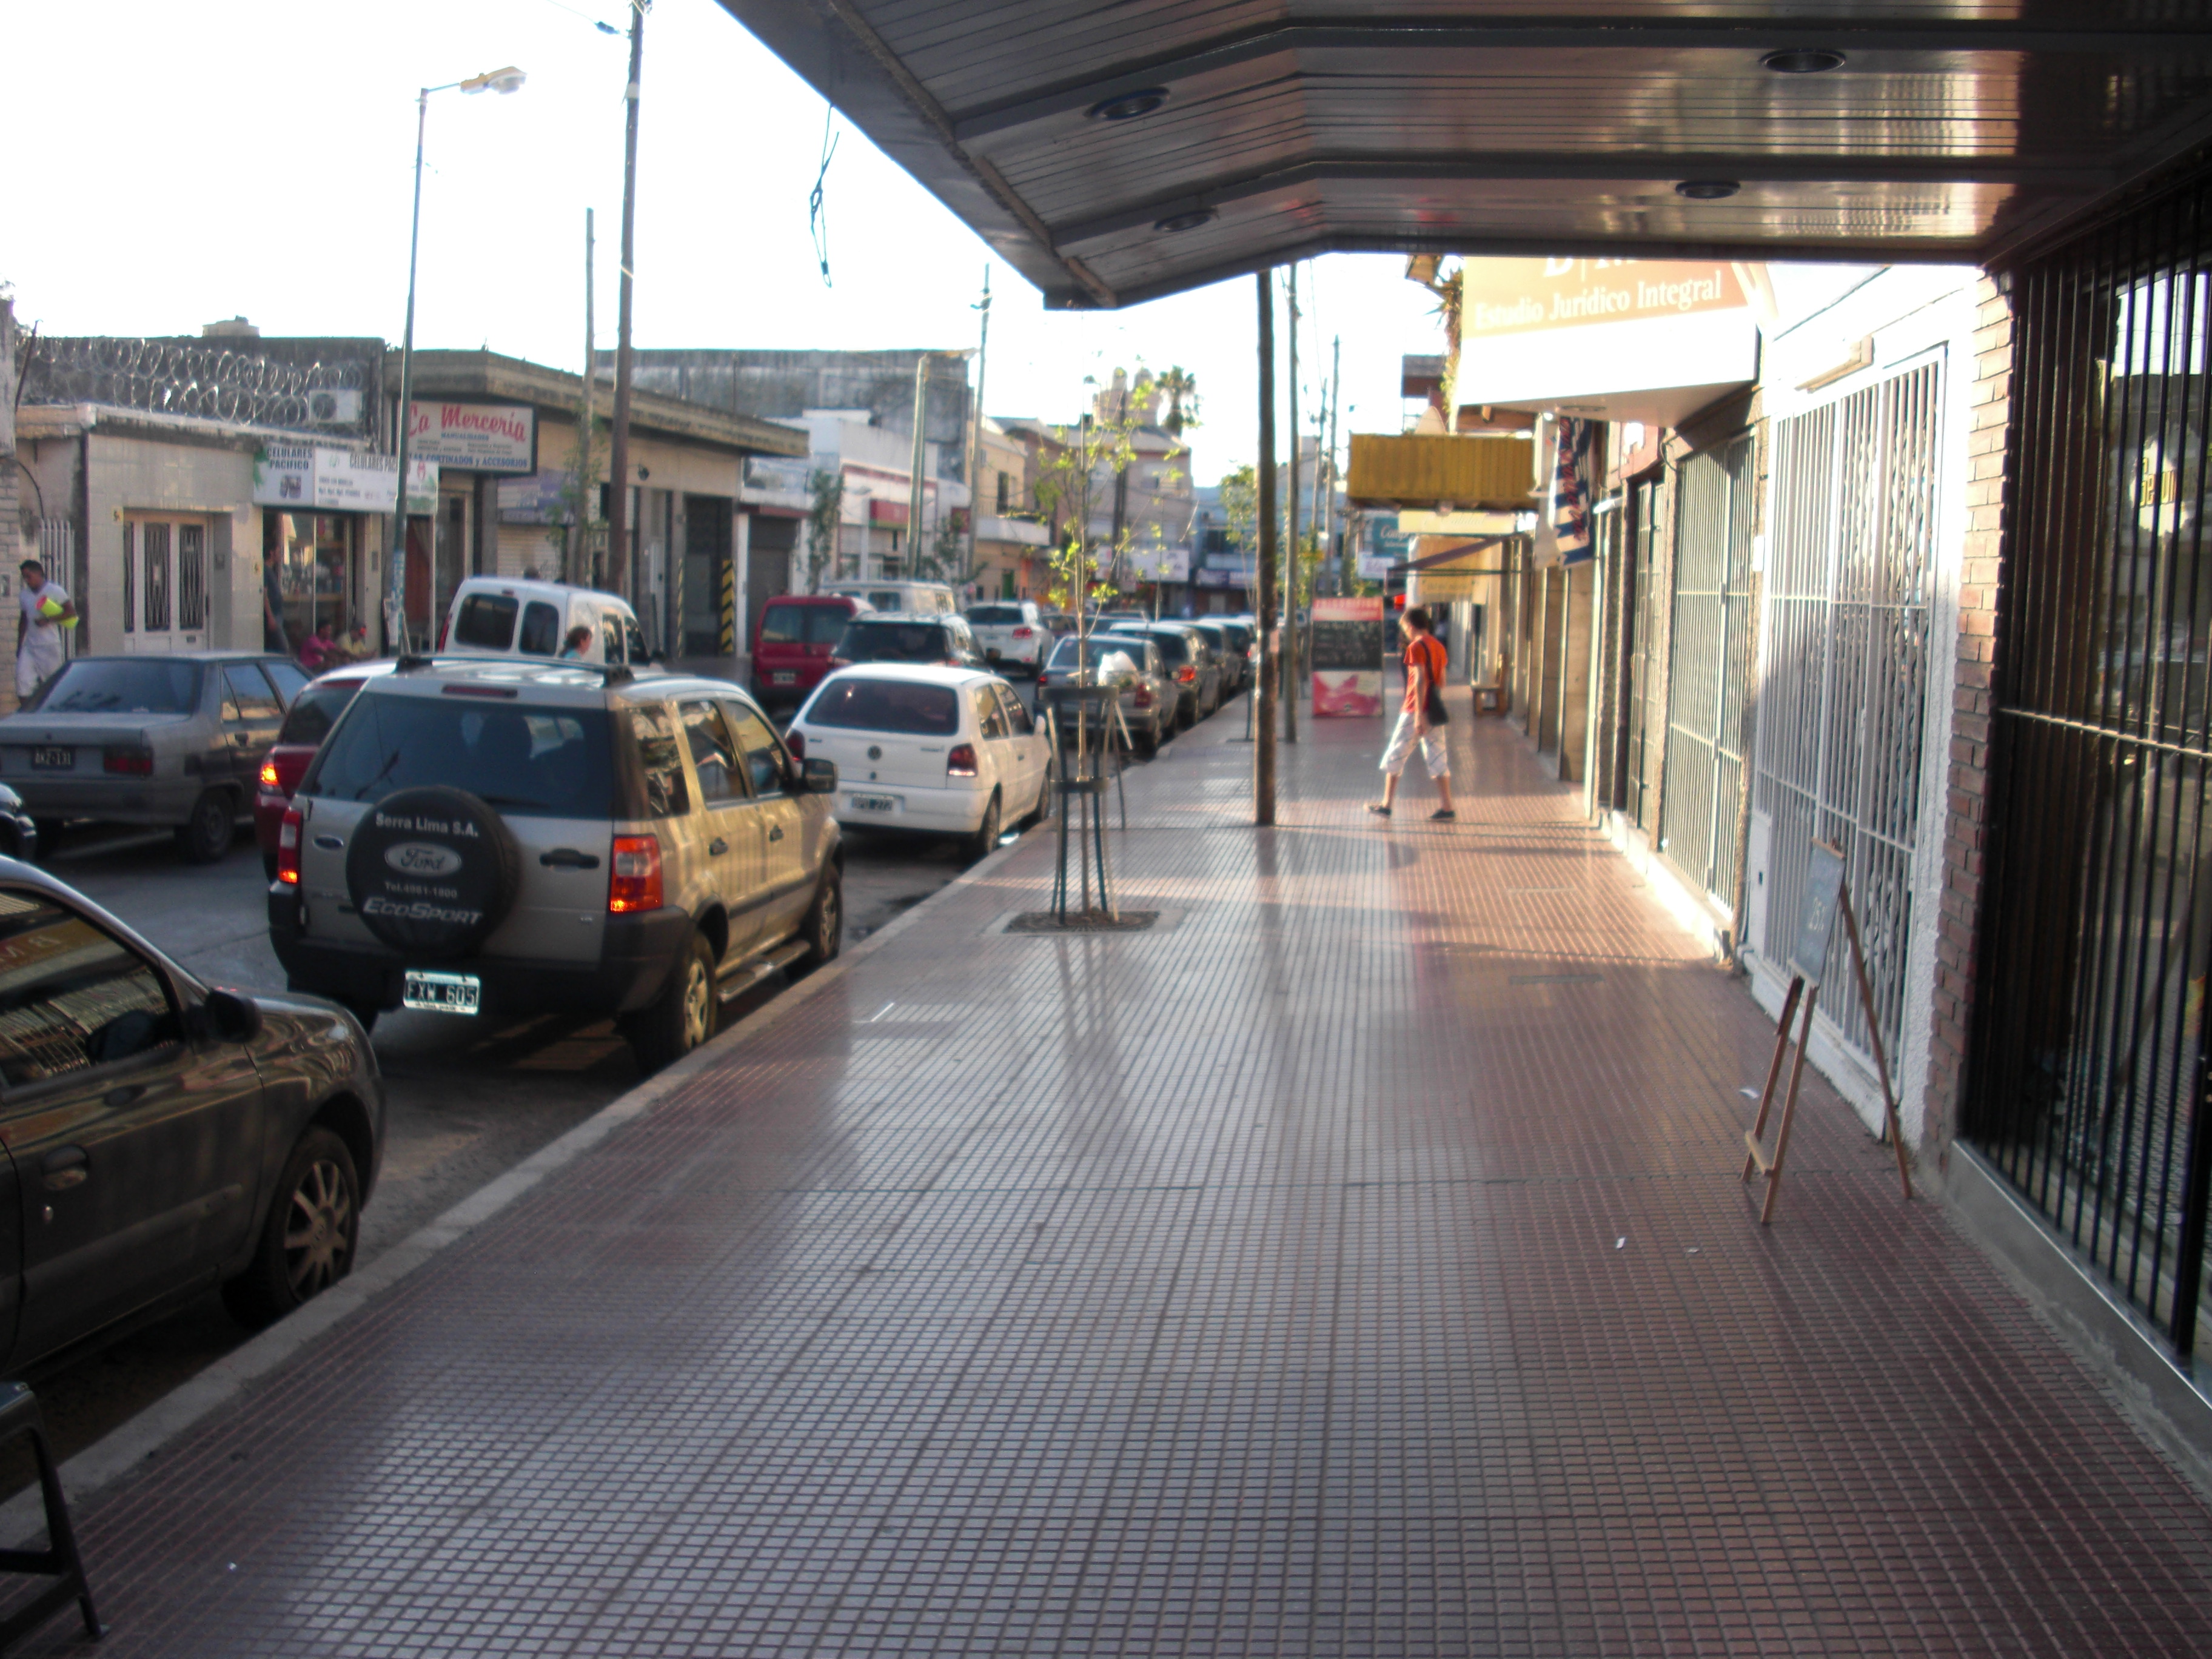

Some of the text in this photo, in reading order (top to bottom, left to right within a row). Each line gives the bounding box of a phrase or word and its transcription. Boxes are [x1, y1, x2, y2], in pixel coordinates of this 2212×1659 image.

[1474, 296, 1544, 330] Estudio
[1637, 269, 1722, 311] Integral
[266, 447, 312, 458] CELULARES
[481, 456, 528, 468] ACCESORIOS
[270, 460, 309, 470] PACIFICO
[375, 812, 479, 837] Serra Lima S.A.
[400, 848, 446, 870] Ford
[446, 985, 475, 1006] 605
